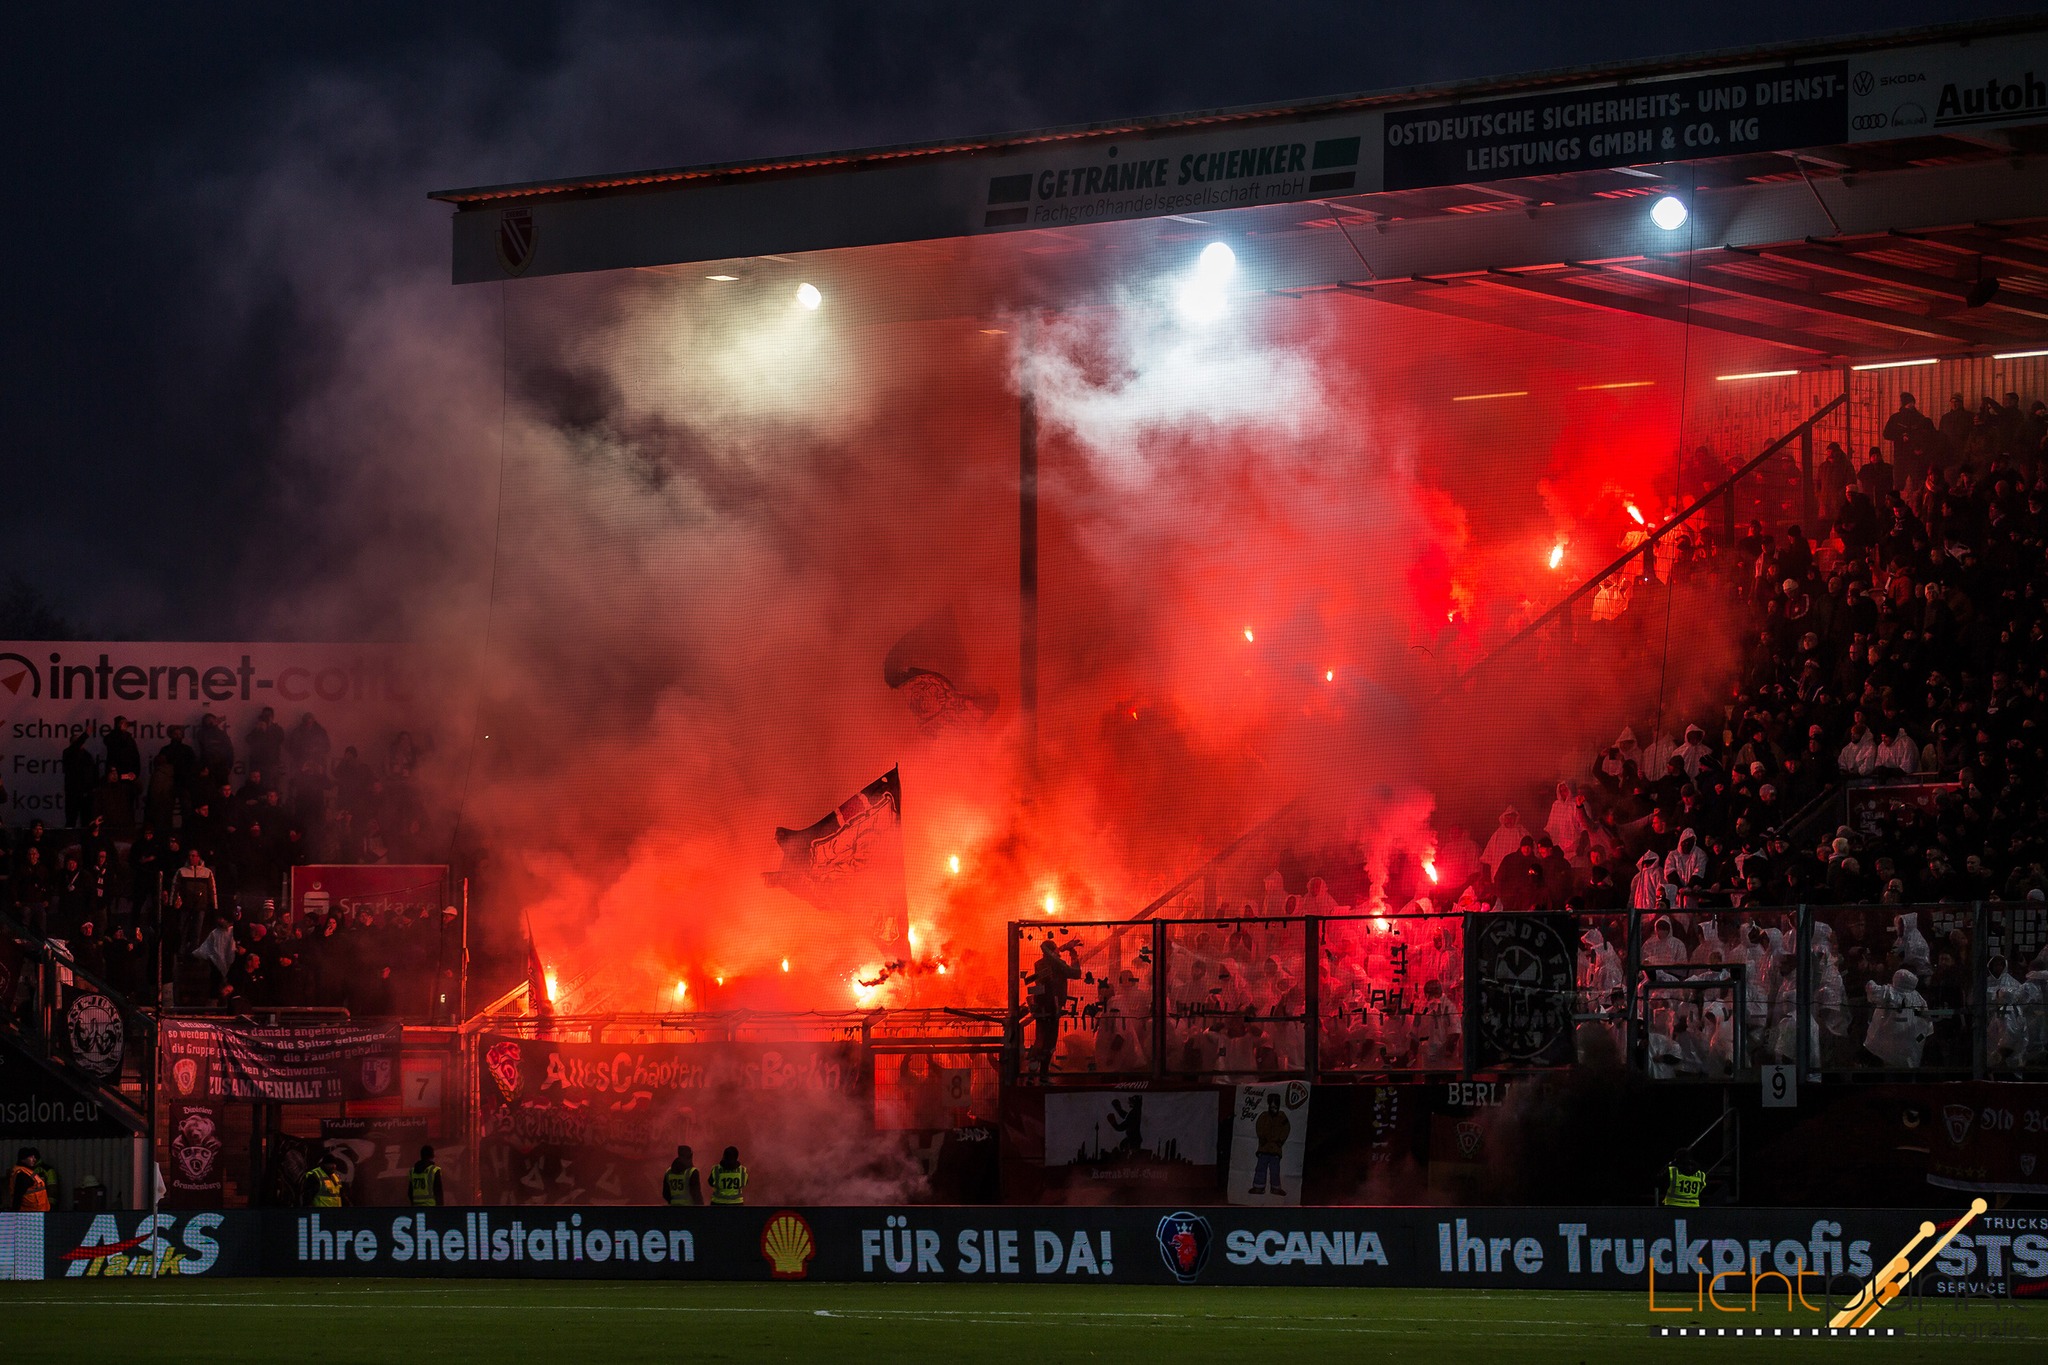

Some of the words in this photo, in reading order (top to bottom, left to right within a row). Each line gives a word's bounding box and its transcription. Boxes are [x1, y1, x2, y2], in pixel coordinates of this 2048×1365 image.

[1388, 109, 1535, 147] OSTDEUTSCHE
[1543, 92, 1690, 131] SICHERHEITS-
[1698, 84, 1751, 113] UND
[1756, 74, 1845, 106] DIENST-
[1467, 137, 1581, 171] LEISTUNGS
[1589, 127, 1653, 158] GMBH
[1660, 126, 1677, 149] &
[1684, 123, 1721, 147] CO.
[1730, 117, 1760, 143] KG
[1178, 143, 1306, 186] SCHENKER
[1034, 182, 1260, 224] Fachgroßhandelsgesellschaft
[1265, 178, 1304, 197] mbH
[13, 719, 120, 738] schnelle
[168, 1030, 178, 1039] so
[180, 1029, 209, 1040] werden
[276, 1040, 295, 1050] die
[297, 1039, 332, 1050] Spitze
[251, 1027, 291, 1037] damals
[172, 1043, 185, 1054] die
[186, 1043, 215, 1058] Gruppe
[283, 1052, 301, 1063] die
[209, 1075, 323, 1099] ZUSAMMENHALT
[326, 1077, 342, 1097] !!!
[415, 1078, 430, 1101] 7
[950, 1074, 963, 1100] 8
[1771, 1072, 1786, 1100] 9
[323, 1119, 366, 1129] Tradition
[372, 1117, 428, 1130] verpflichtet
[1979, 1107, 2015, 1131] Old
[721, 1177, 740, 1189] 129
[1679, 1180, 1698, 1194] 139
[1983, 1216, 2048, 1230] TRUCKS
[65, 1212, 225, 1277] ASS
[298, 1214, 378, 1262] Ihre
[392, 1211, 694, 1263] Shellstationen
[861, 1215, 944, 1274] FÜR
[957, 1228, 1020, 1274] SIE
[1034, 1229, 1112, 1277] DA!
[1226, 1229, 1388, 1266] SCANIA
[1438, 1218, 1544, 1274] Ihre
[1559, 1218, 1873, 1290] Truckprofis
[1935, 1233, 2048, 1278] STS
[1936, 1281, 2007, 1294] SERVICE
